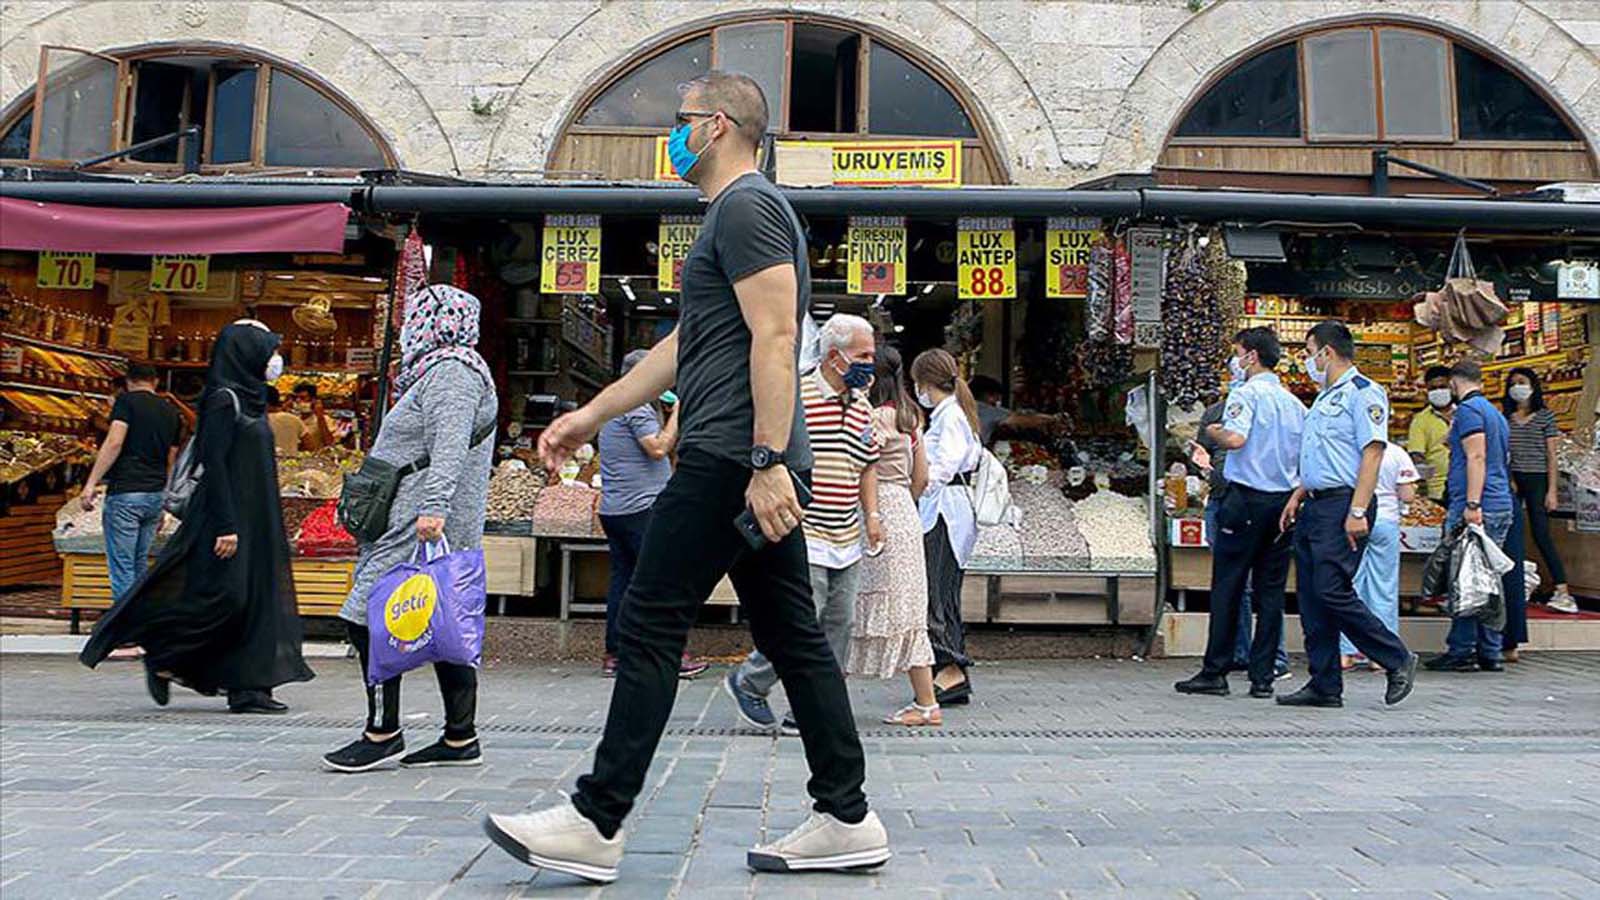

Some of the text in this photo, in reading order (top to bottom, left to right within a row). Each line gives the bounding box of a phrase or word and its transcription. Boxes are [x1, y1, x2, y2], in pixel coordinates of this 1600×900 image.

[832, 151, 945, 173] URUYEMiŞ
[667, 227, 697, 241] KIN
[850, 243, 903, 263] FINDIK
[960, 250, 1013, 265] ANTEP
[1050, 249, 1090, 265] SiiR
[54, 259, 81, 285] 70
[164, 263, 196, 289] 70
[971, 267, 1004, 295] 88
[392, 594, 428, 621] getir
